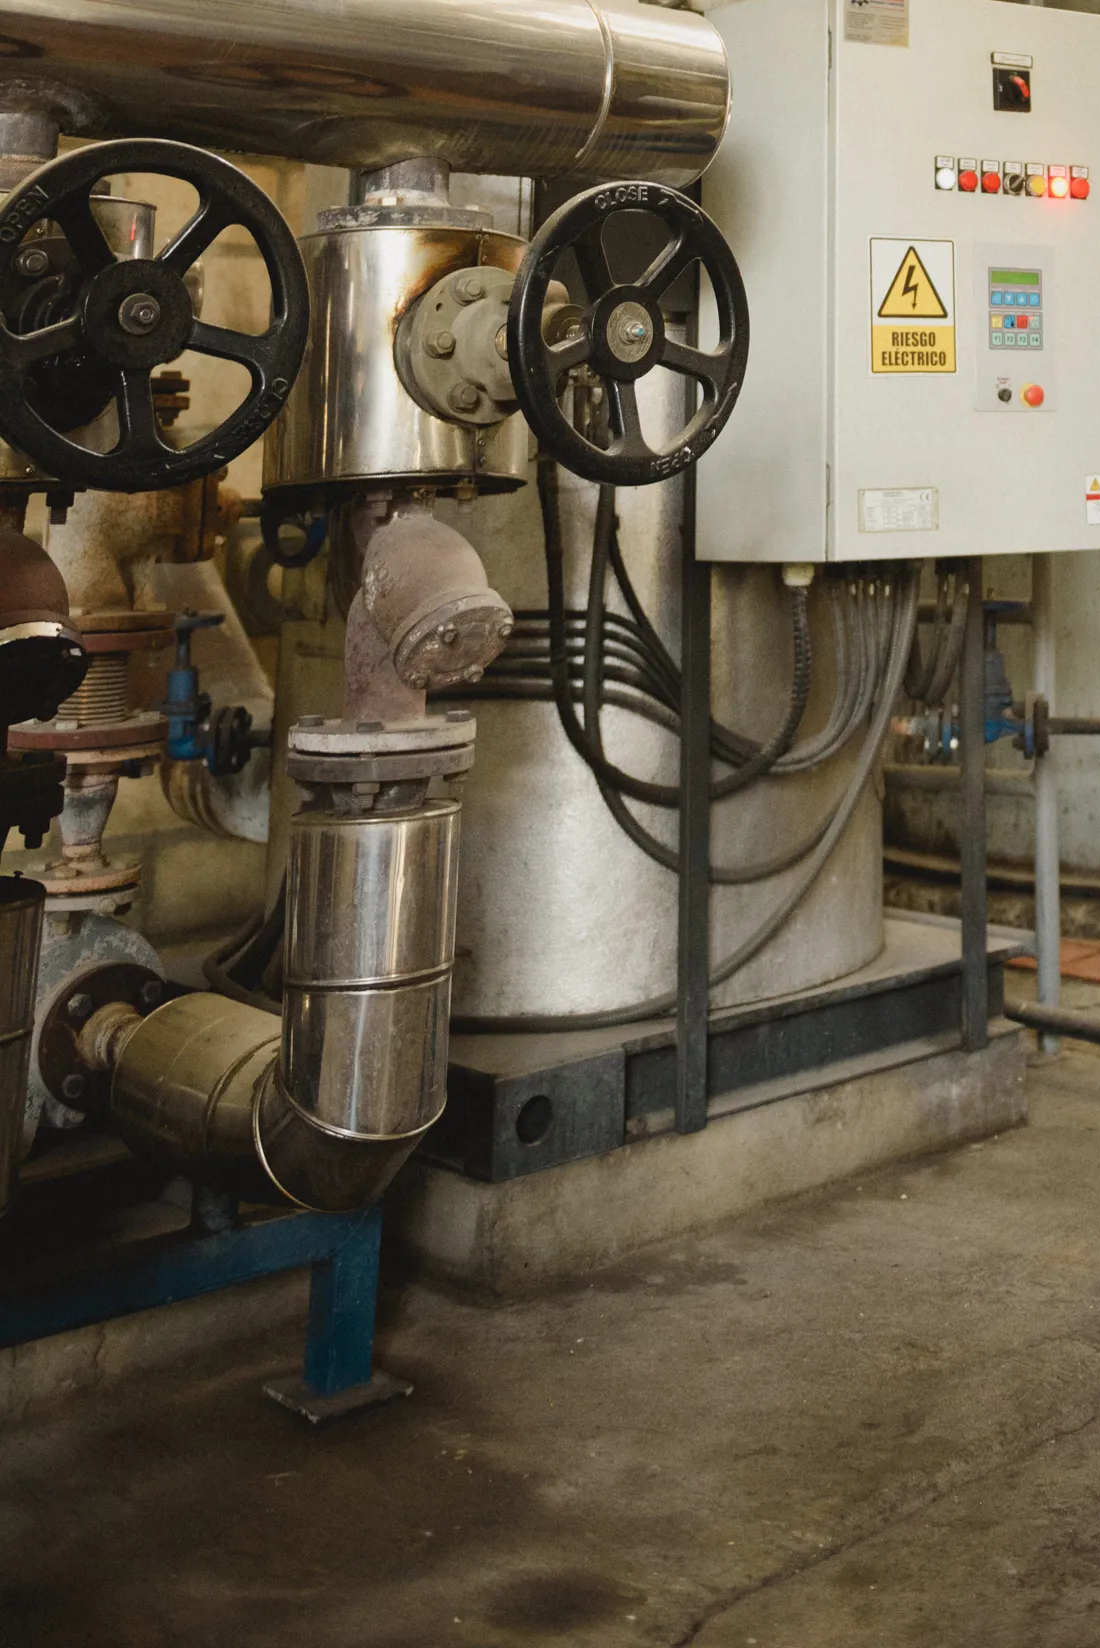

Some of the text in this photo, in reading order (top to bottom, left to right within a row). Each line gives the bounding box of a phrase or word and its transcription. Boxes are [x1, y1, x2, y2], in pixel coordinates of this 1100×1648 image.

[594, 186, 649, 210] CLOSE
[891, 331, 936, 347] RIESGO
[1006, 335, 1014, 343] F2
[1031, 336, 1039, 344] F4
[881, 348, 947, 367] ELÉCTRICO
[650, 446, 695, 474] OPEN
